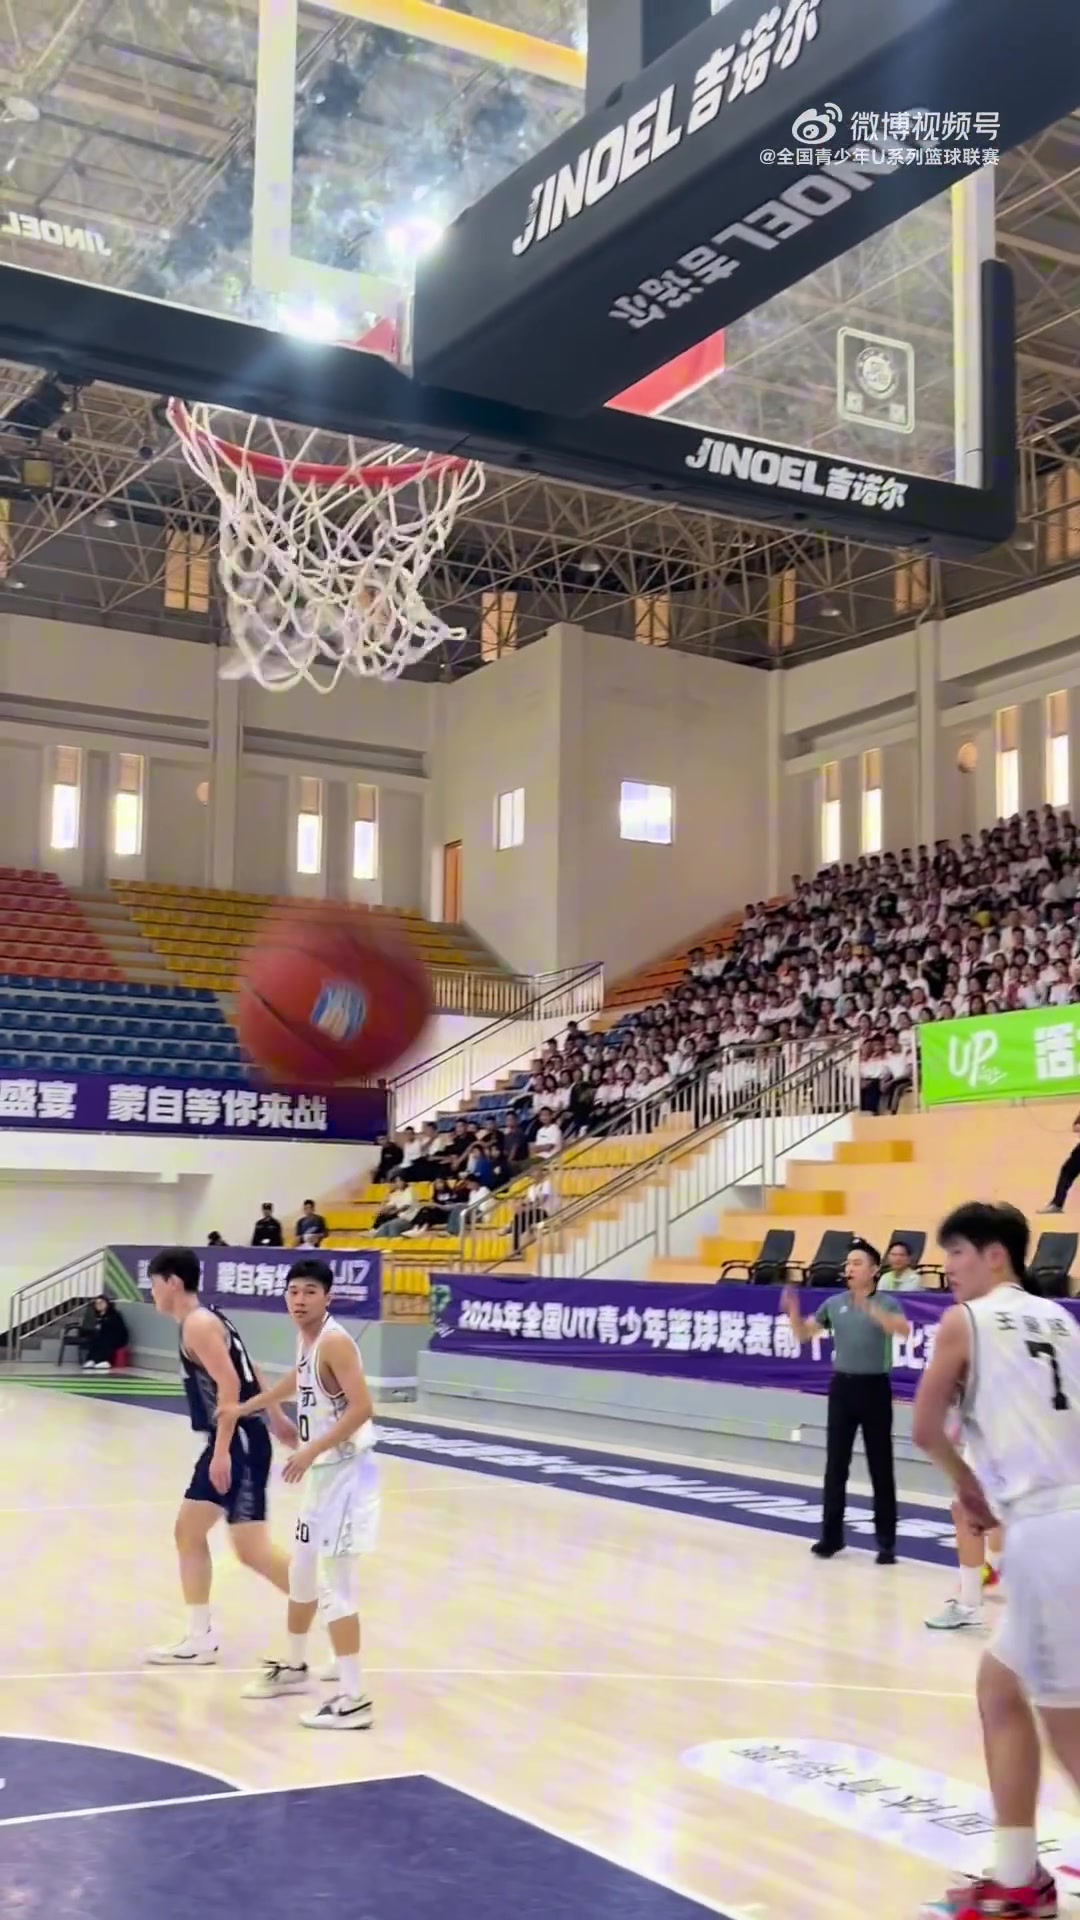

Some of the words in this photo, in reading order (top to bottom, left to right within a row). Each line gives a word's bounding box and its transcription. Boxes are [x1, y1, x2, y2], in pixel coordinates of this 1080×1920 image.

[512, 84, 683, 256] JINOEL
[687, 0, 821, 136] 吉诺尔
[685, 437, 825, 496] JINOEL
[825, 466, 909, 511] 吉诺尔
[1034, 1022, 1080, 1080] 活
[0, 1079, 77, 1119] 盛宴
[107, 1083, 328, 1131] 蒙自等你来战
[1024, 1339, 1071, 1411] 7
